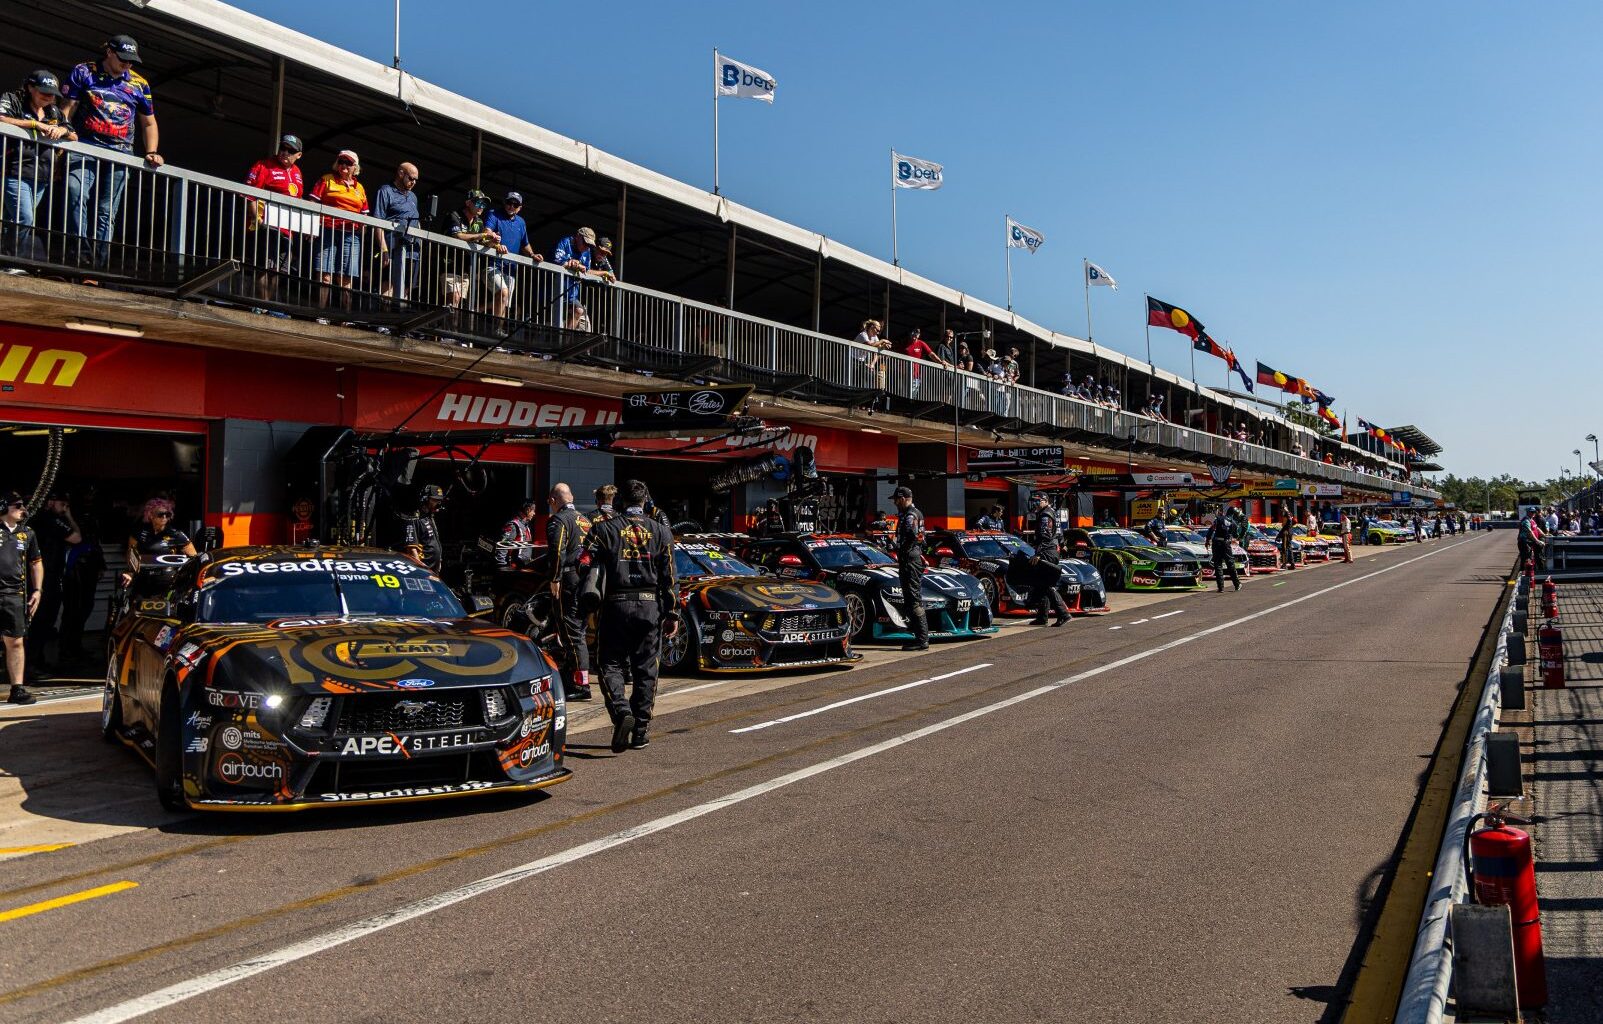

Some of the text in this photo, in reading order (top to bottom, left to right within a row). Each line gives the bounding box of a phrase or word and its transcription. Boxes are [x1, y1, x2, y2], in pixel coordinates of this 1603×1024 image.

[437, 393, 586, 427] HIDDEN
[652, 406, 678, 416] Racing
[997, 448, 1019, 457] Mbil
[1031, 447, 1062, 456] OPTUS
[620, 529, 653, 542] PENITE
[222, 558, 386, 577] Steadfast
[371, 574, 401, 588] 19
[1132, 576, 1157, 585] RYCO
[783, 632, 834, 646] APEX STEEL
[720, 645, 756, 656] airtouch
[404, 679, 428, 688] Ford
[243, 730, 260, 739] mits
[341, 731, 475, 759] APEX STEEL
[521, 740, 550, 761] airtouch
[222, 761, 282, 778] airtouch
[320, 784, 453, 802] Steadfast
